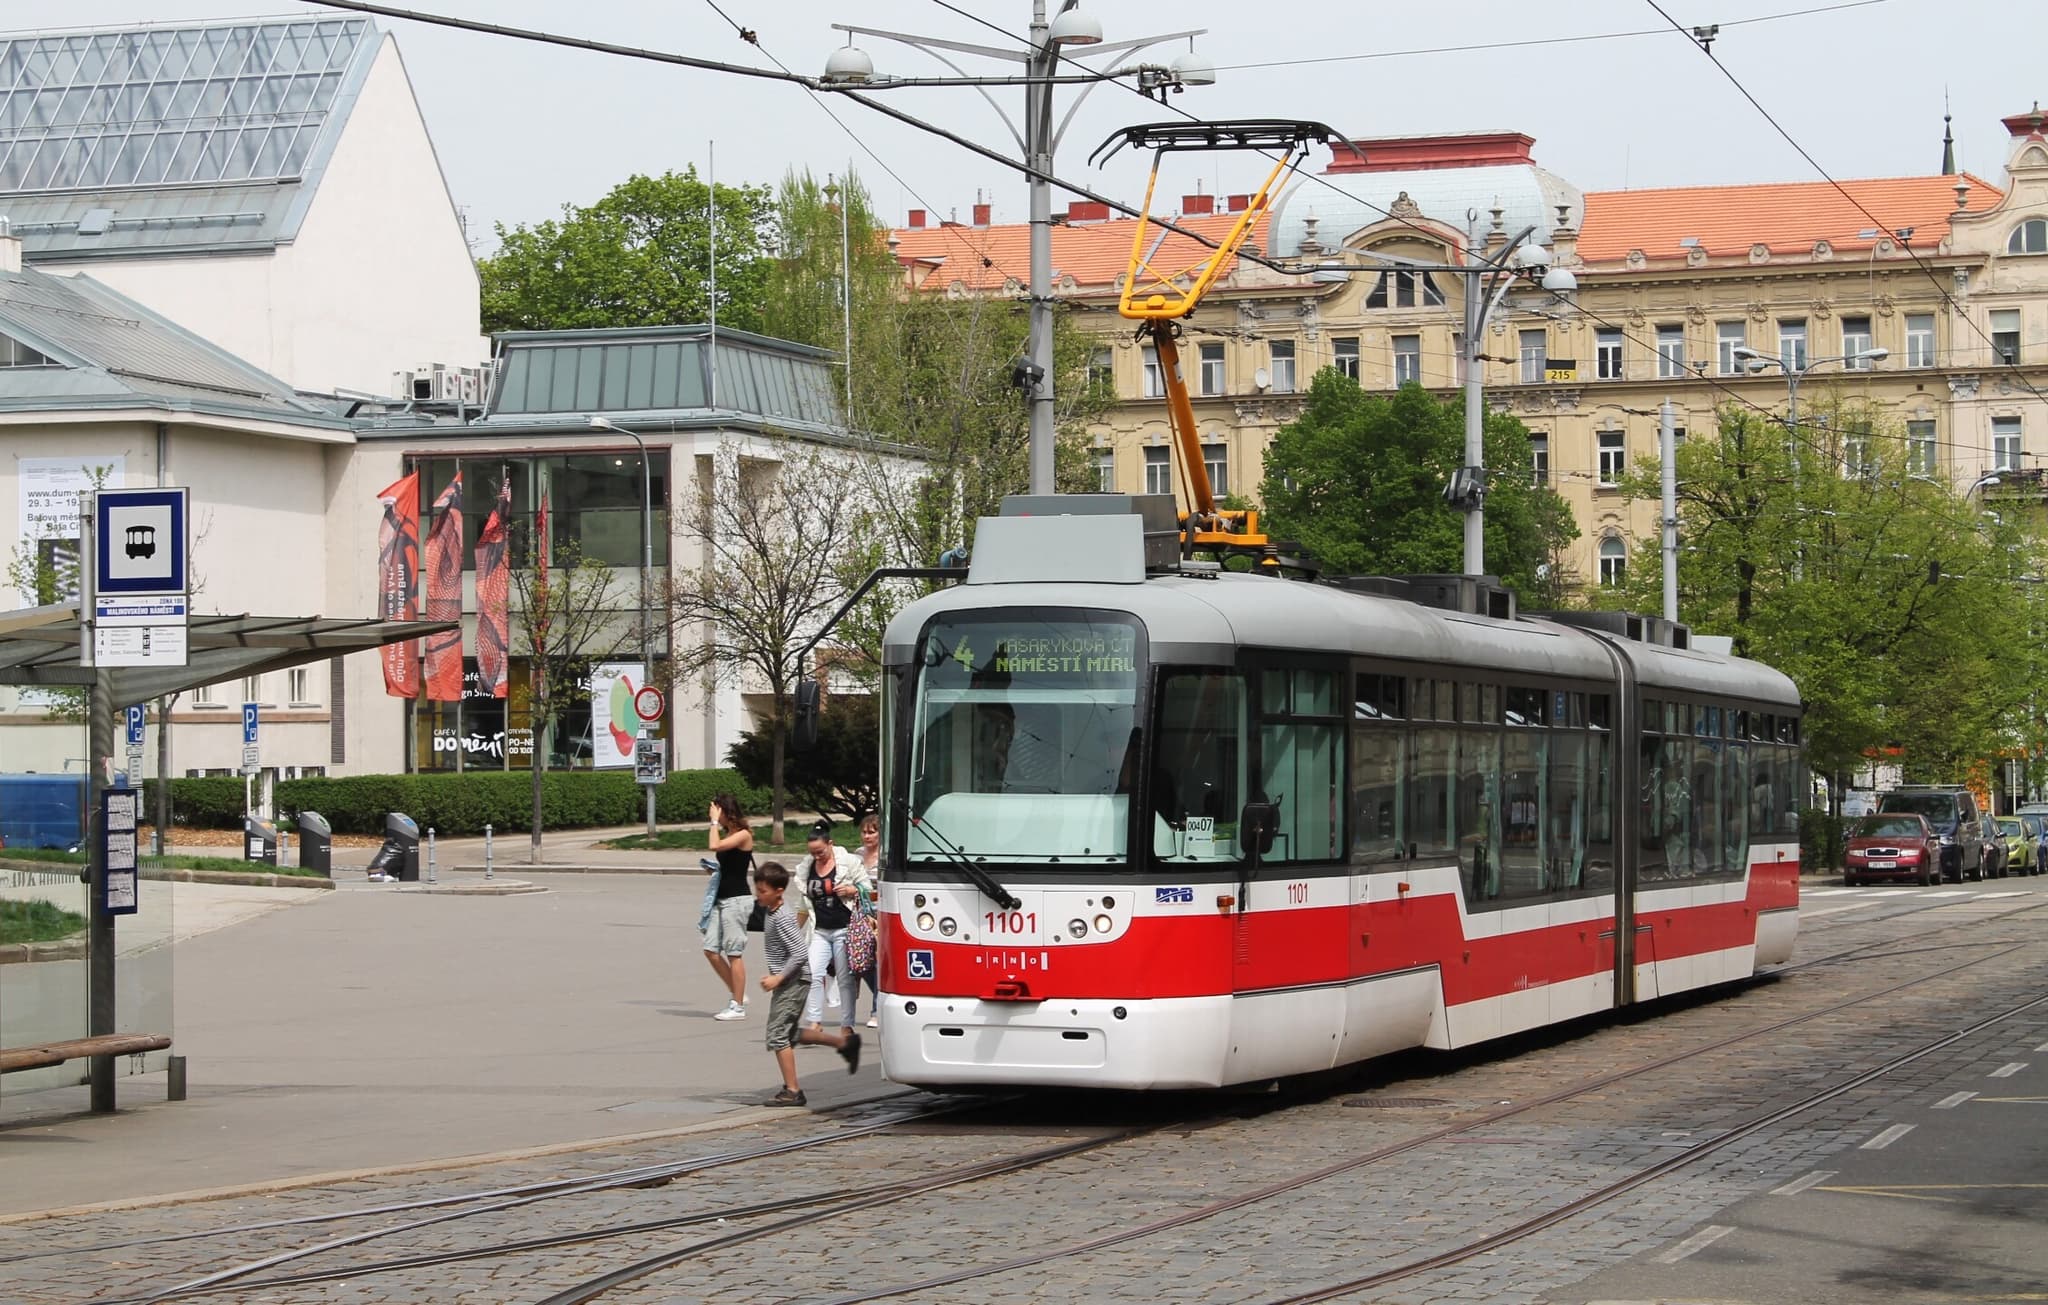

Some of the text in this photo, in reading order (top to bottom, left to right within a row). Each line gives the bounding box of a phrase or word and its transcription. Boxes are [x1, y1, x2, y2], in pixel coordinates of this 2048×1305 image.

[1551, 370, 1570, 380] 215
[954, 636, 974, 672] 4
[996, 638, 1104, 652] MASARYKOVA
[996, 654, 1081, 672] NÁMĚSTÍ
[246, 708, 255, 732] P
[434, 728, 450, 736] CAFÉ
[1288, 883, 1308, 904] 1101
[984, 912, 1036, 934] 1101
